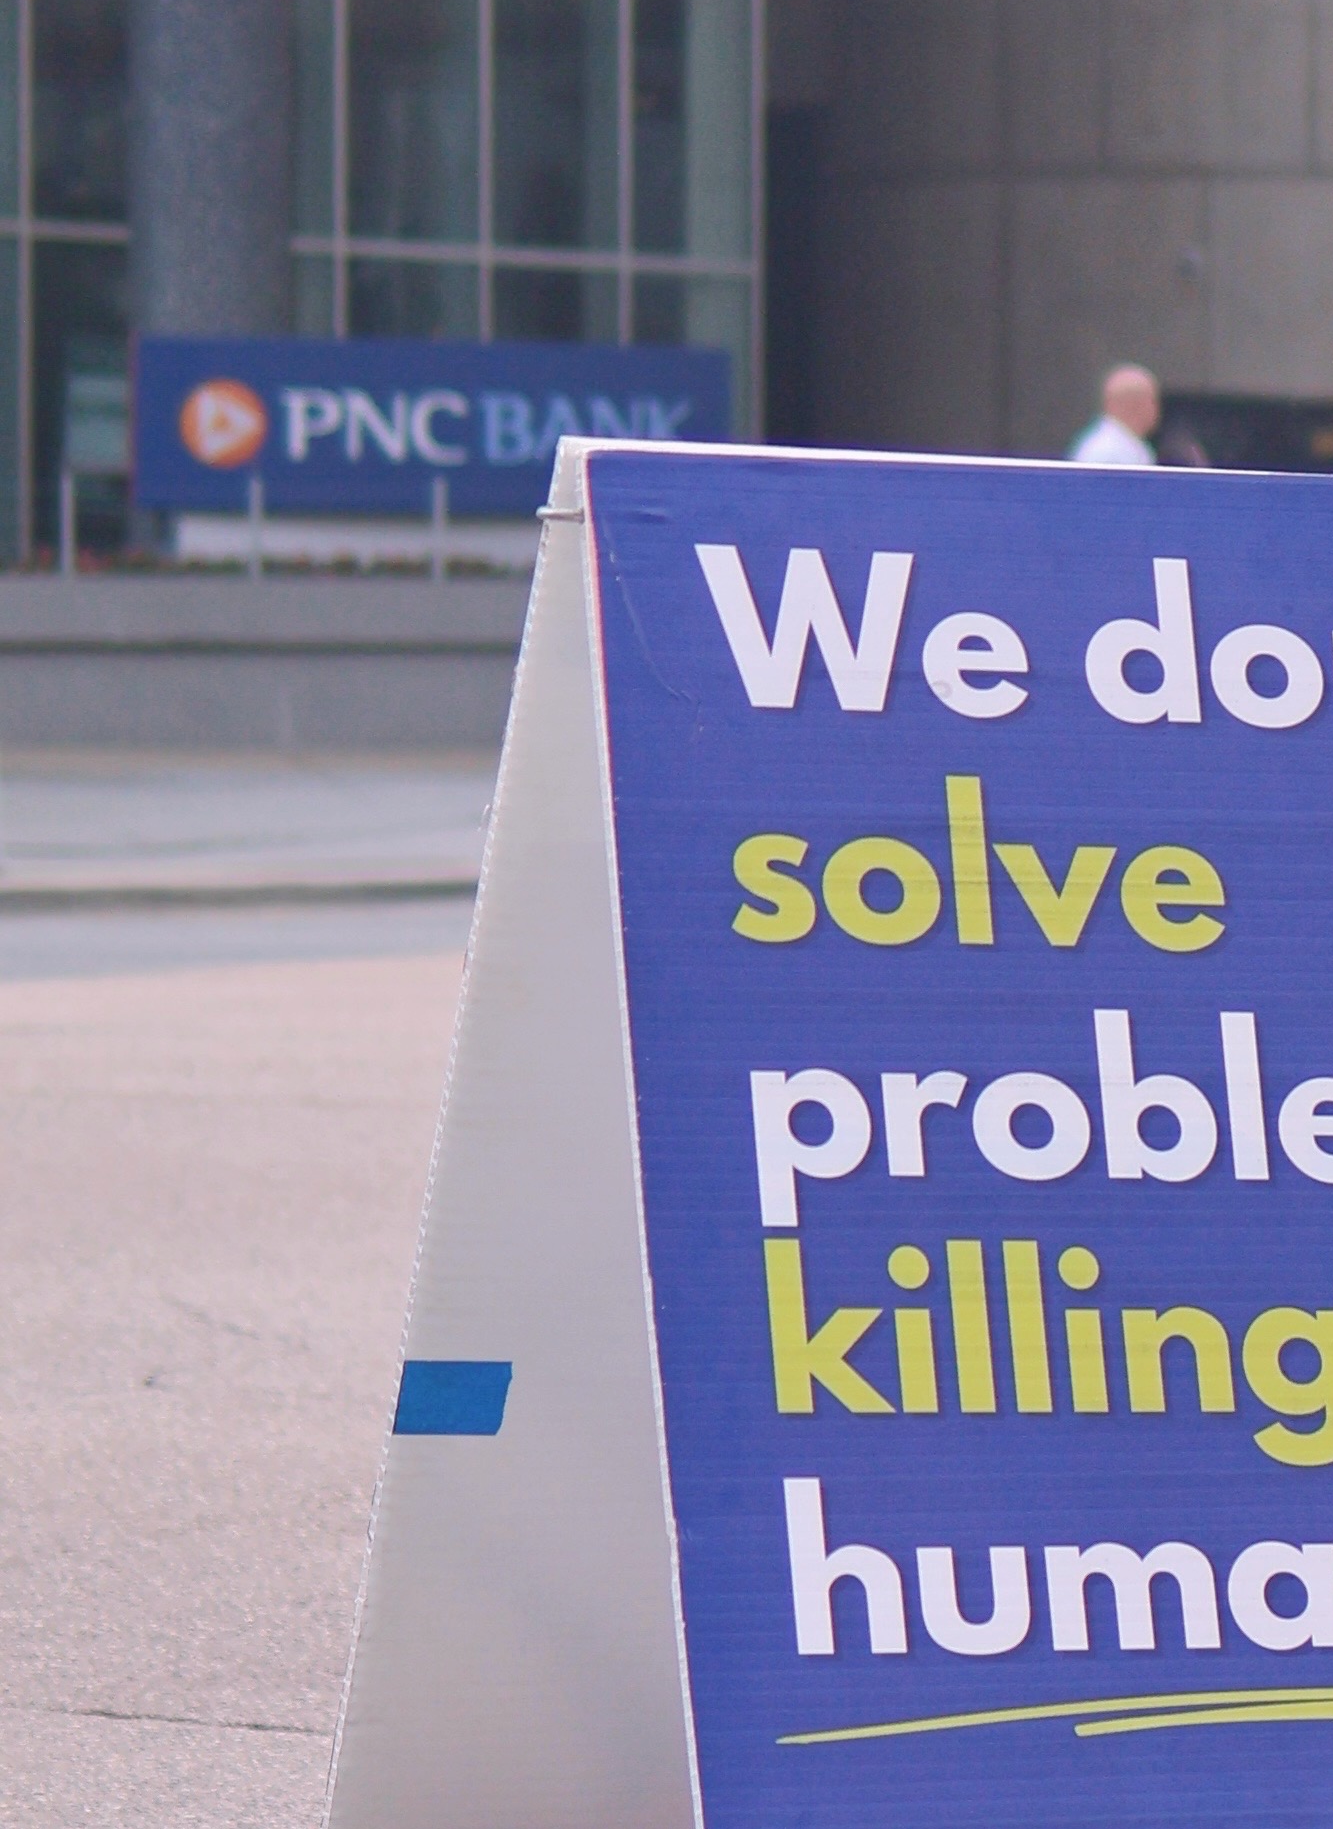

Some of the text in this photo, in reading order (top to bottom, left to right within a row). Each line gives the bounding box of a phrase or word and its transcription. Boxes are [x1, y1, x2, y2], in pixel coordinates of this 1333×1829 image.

[282, 386, 692, 466] PNC BANK
[694, 544, 1028, 718] We
[732, 776, 1226, 951] solve
